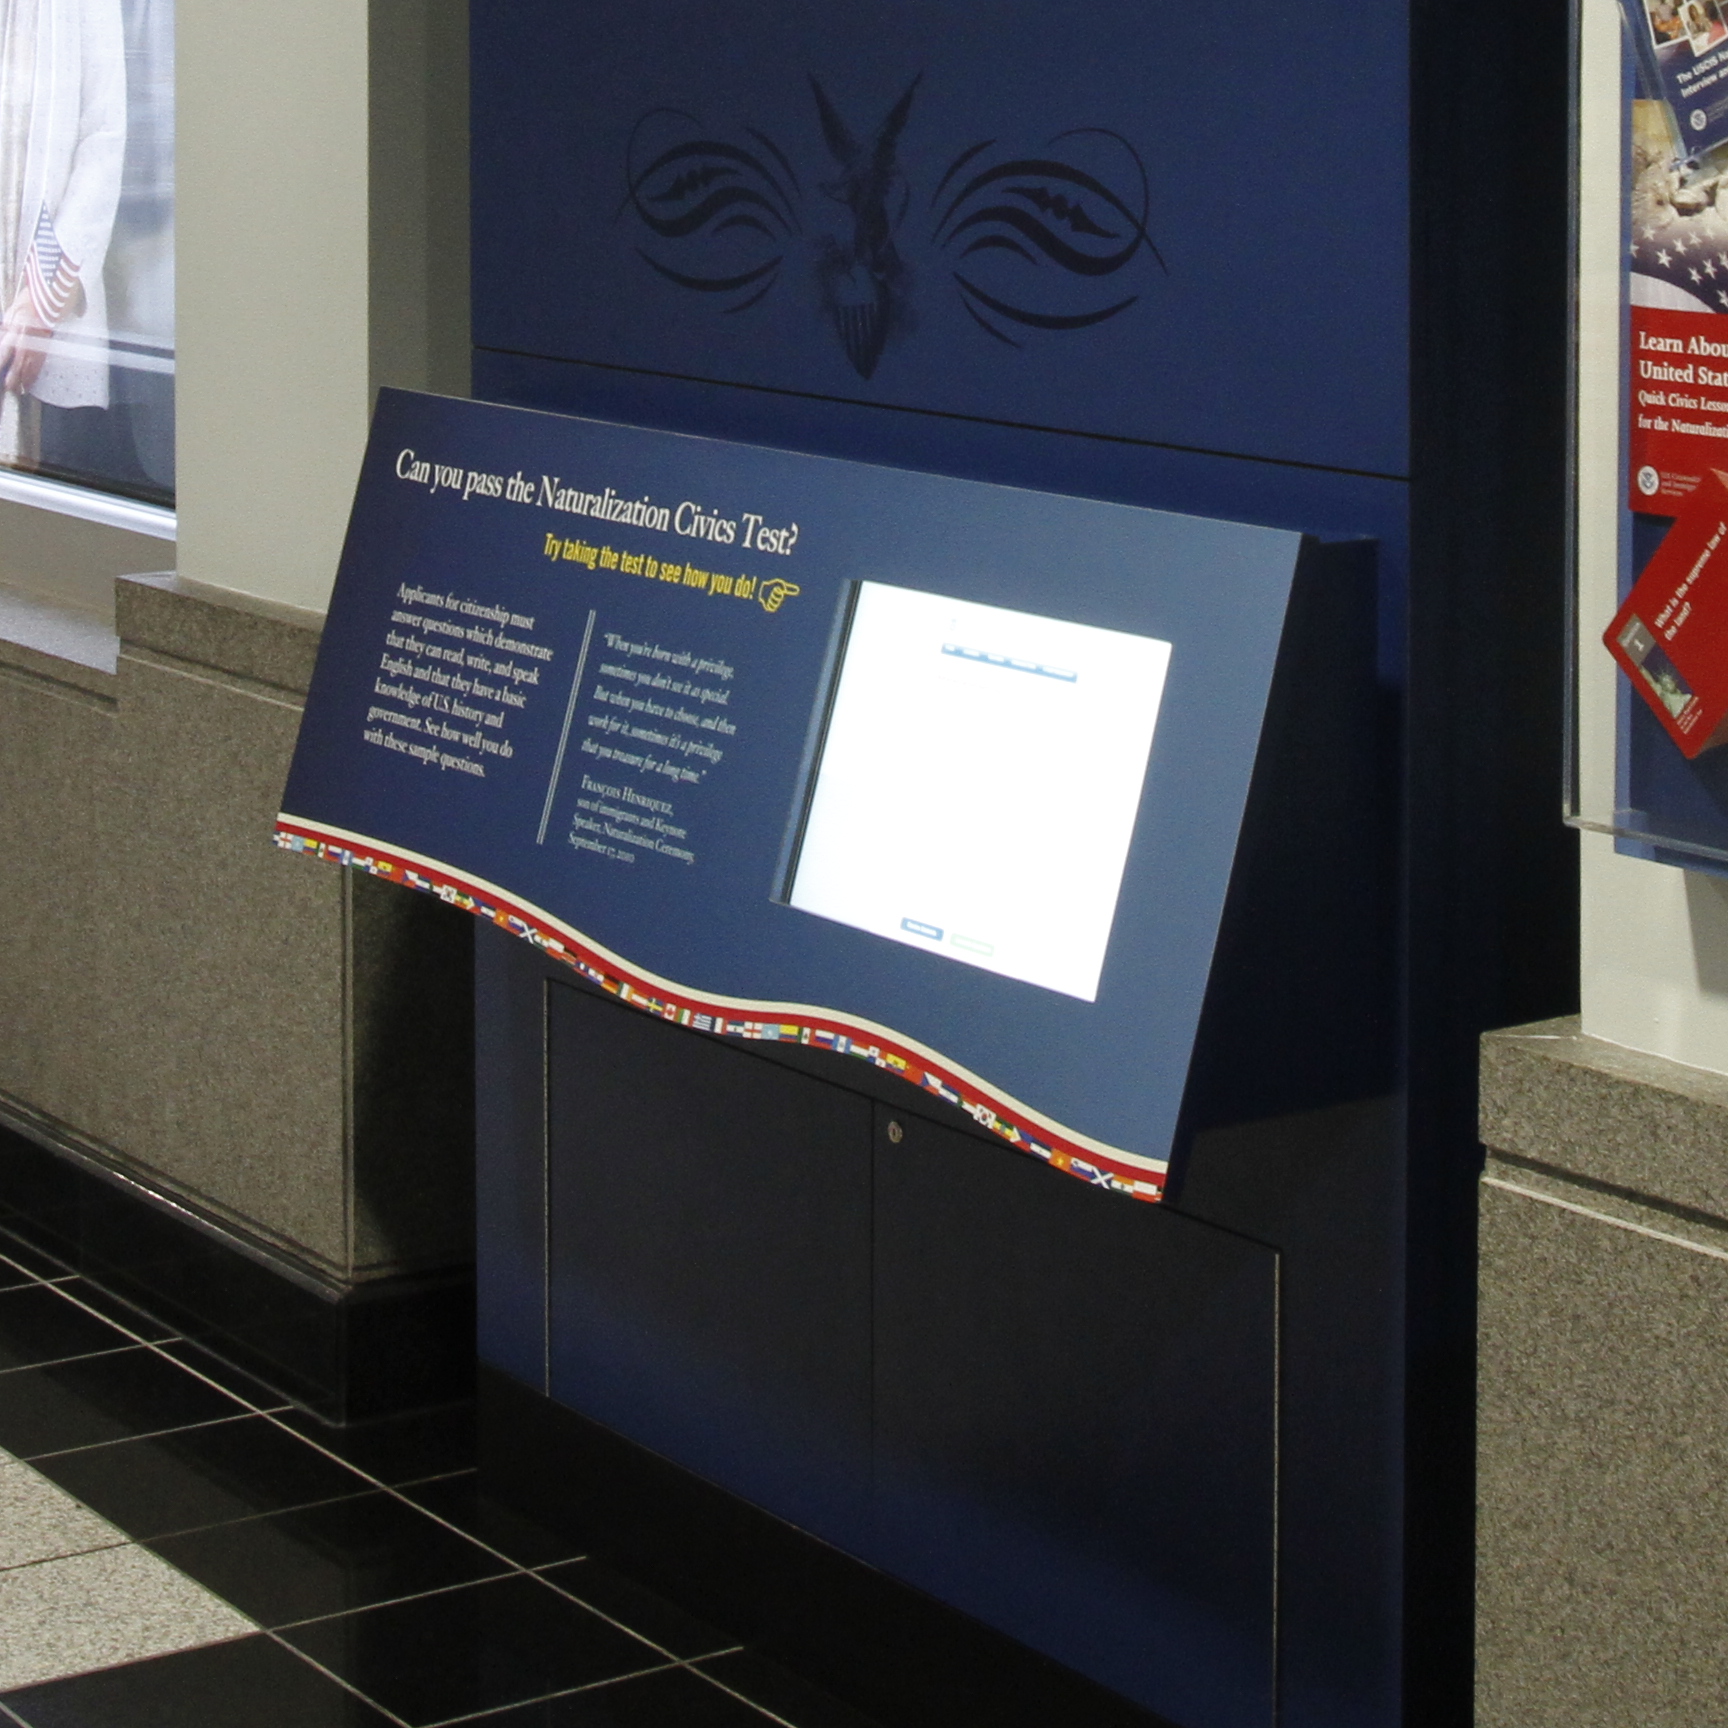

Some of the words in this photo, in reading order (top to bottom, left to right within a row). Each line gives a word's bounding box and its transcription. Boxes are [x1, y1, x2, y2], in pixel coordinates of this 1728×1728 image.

[1676, 71, 1693, 84] The
[1680, 73, 1718, 99] Interview
[1639, 331, 1684, 354] Learn
[1639, 359, 1694, 384] United
[1638, 389, 1667, 407] Quick
[1667, 392, 1699, 410] Civics
[1638, 413, 1653, 429] for
[1653, 415, 1669, 431] the
[396, 448, 431, 484] Can
[429, 464, 464, 494] you
[462, 471, 504, 501] pass
[505, 471, 535, 504] the
[535, 475, 670, 532] Naturalization
[674, 502, 737, 544] Civics
[742, 514, 799, 556] Test?
[544, 532, 562, 561] Try
[562, 538, 599, 570] taking
[599, 545, 619, 570] the
[620, 550, 645, 575] test
[644, 555, 659, 579] to
[658, 562, 682, 584] see
[682, 562, 710, 589] how
[708, 573, 734, 596] you
[733, 573, 758, 600] do!
